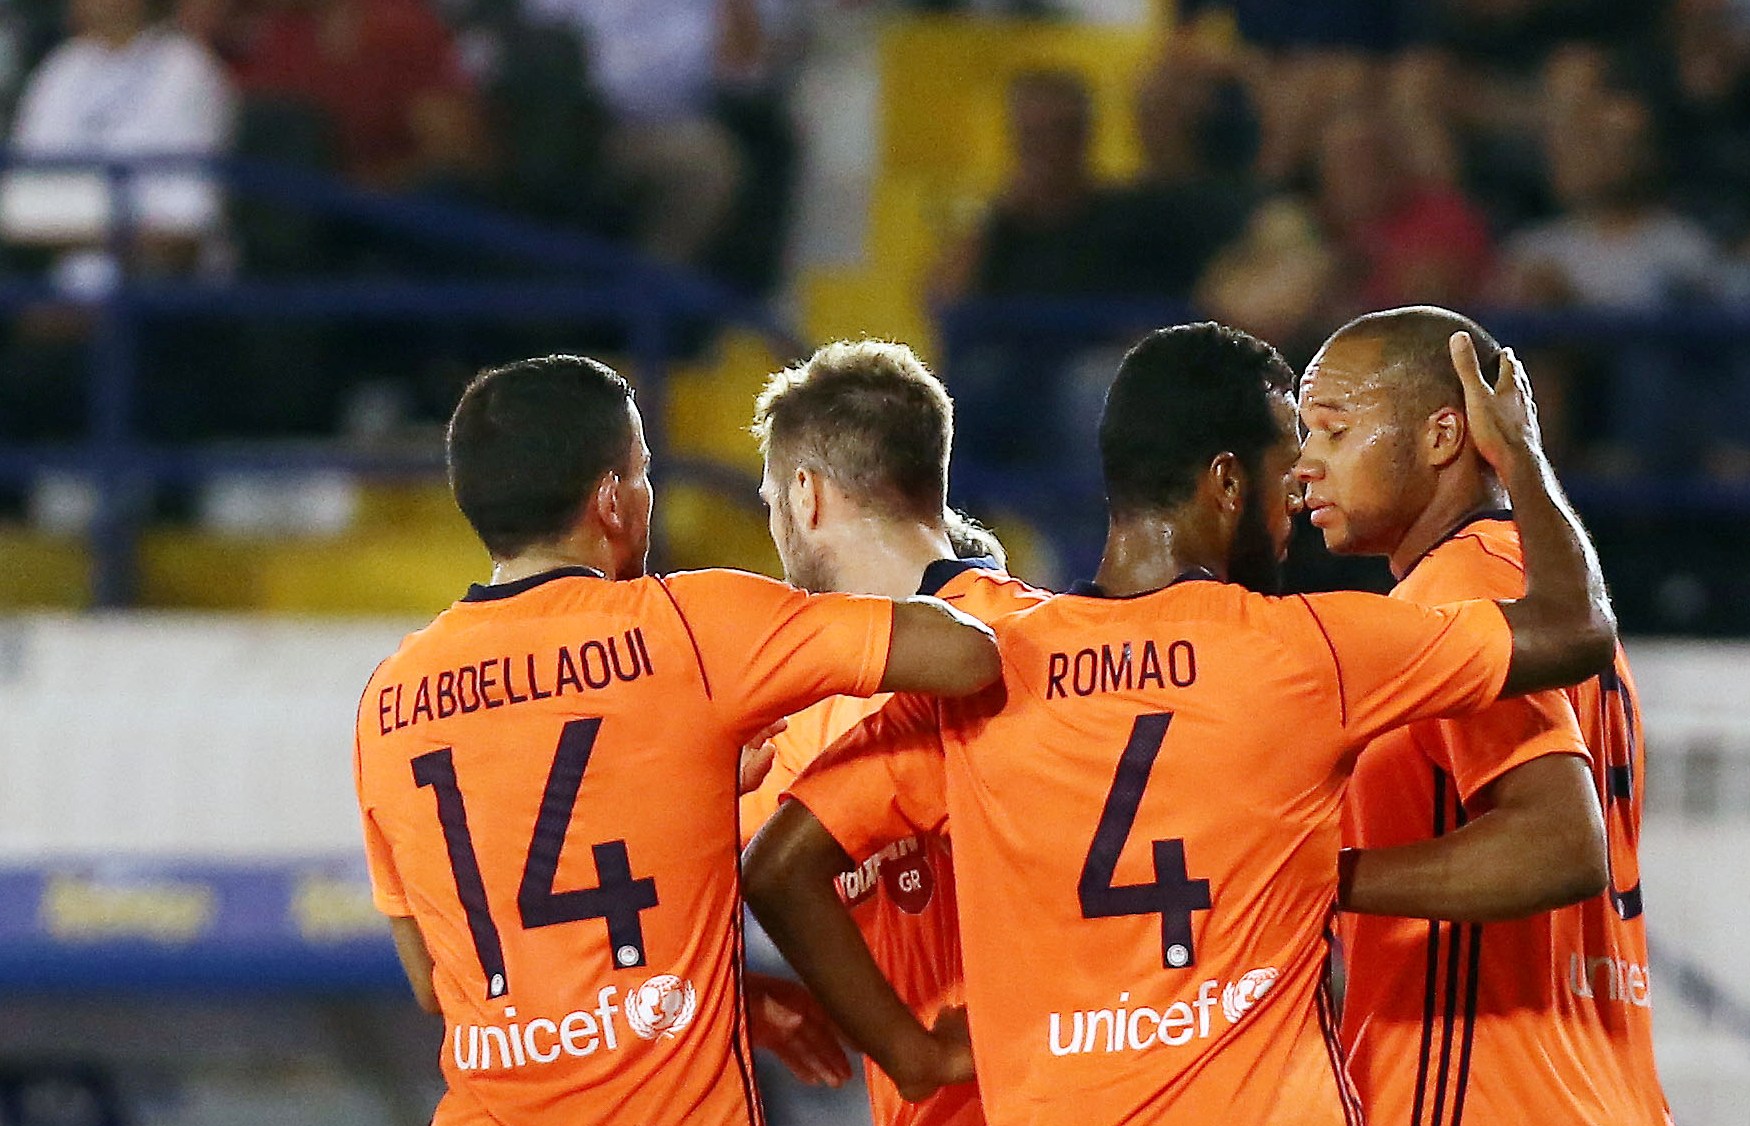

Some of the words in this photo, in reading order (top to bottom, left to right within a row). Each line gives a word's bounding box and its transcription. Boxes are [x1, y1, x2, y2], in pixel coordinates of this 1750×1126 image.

[377, 627, 654, 737] ELABDELLAOUI
[1046, 639, 1197, 700] ROMAO
[410, 716, 659, 1000] 14
[898, 868, 922, 893] GR
[1078, 711, 1212, 969] 4
[454, 985, 617, 1072] unicef
[1048, 995, 1213, 1056] unicef
